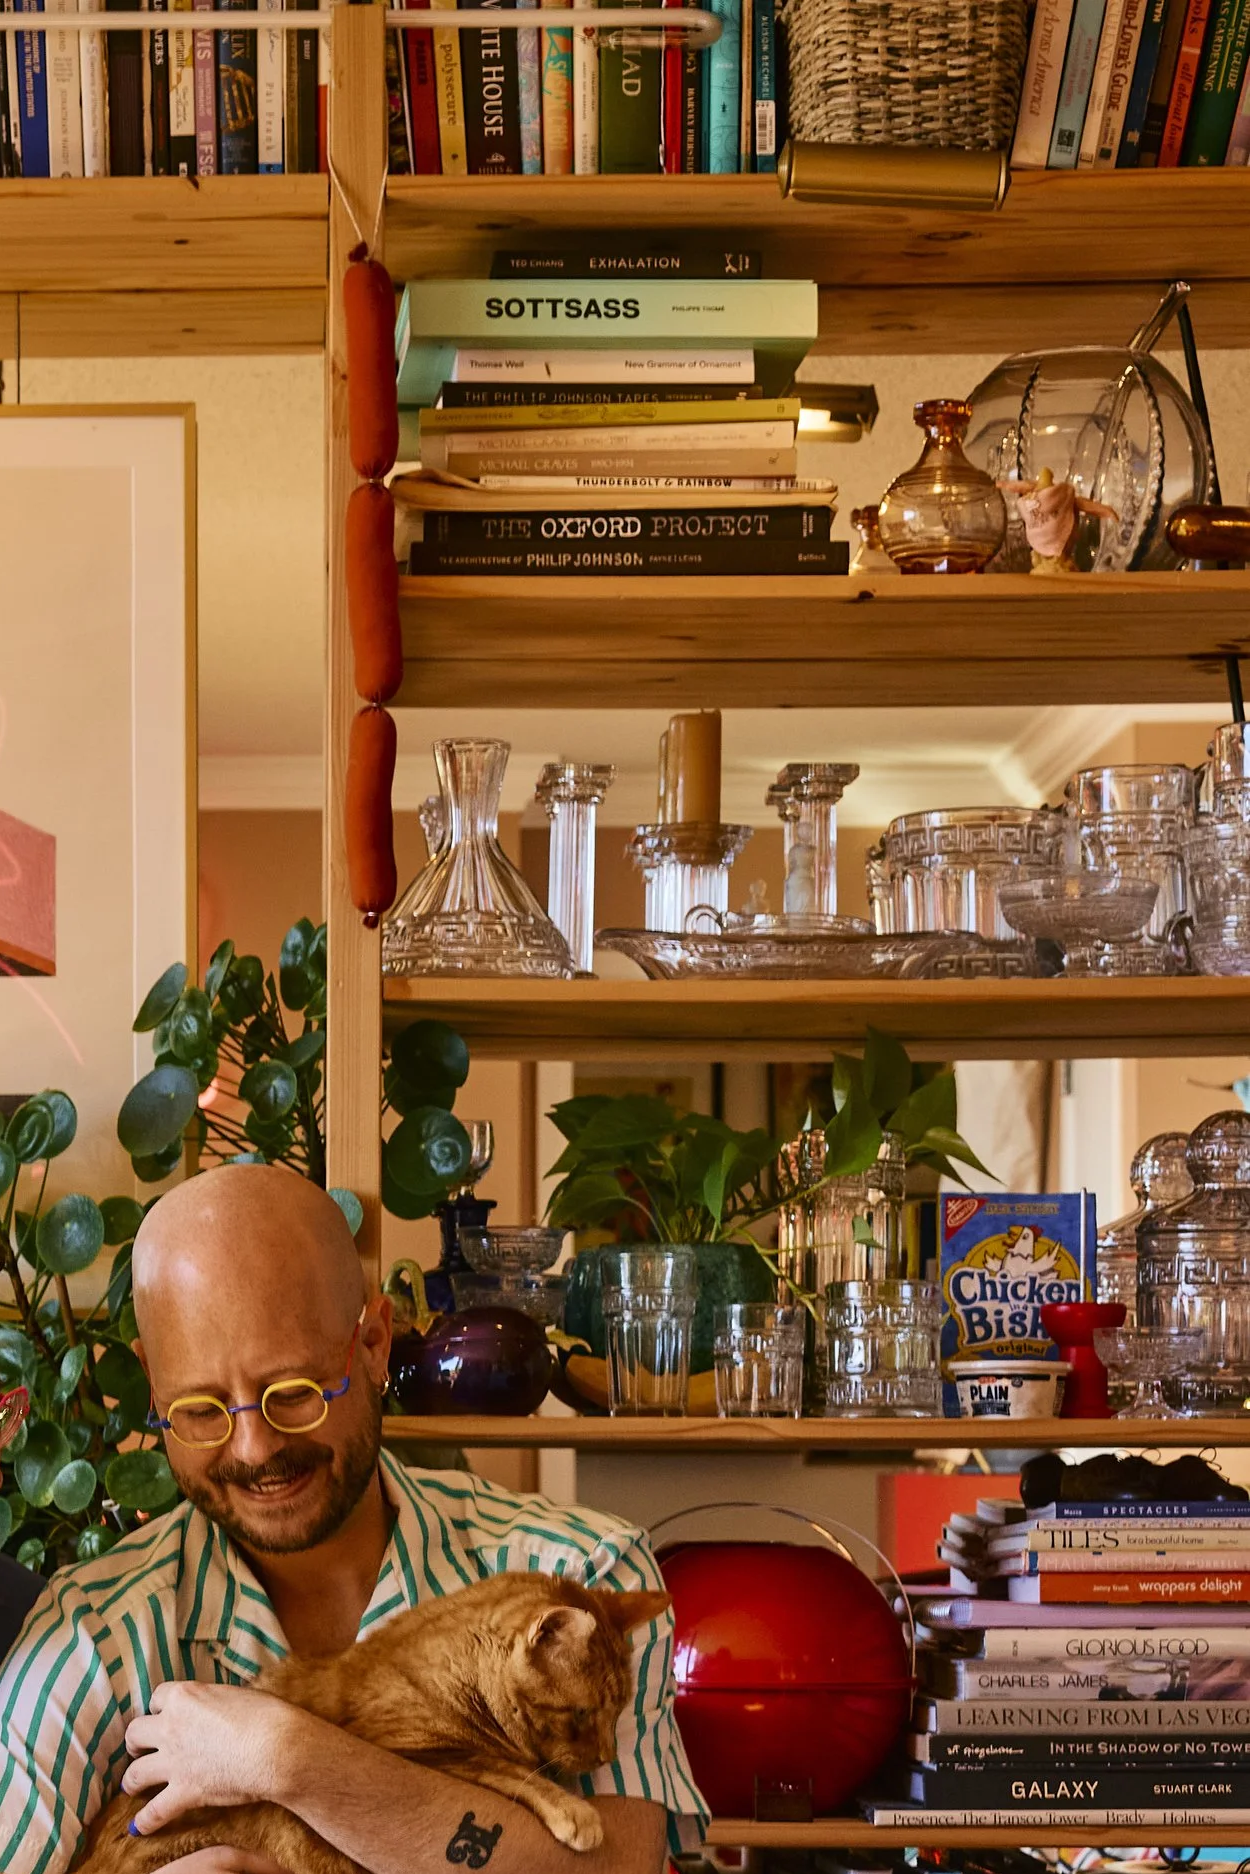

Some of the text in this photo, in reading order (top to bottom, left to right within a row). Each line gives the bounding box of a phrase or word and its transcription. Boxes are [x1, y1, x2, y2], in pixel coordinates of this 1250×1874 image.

[1202, 18, 1228, 92] GARDENING
[438, 43, 460, 126] polysecure
[1106, 72, 1128, 112] GUIDE
[481, 64, 506, 138] HOUSE
[589, 257, 680, 268] EXHALATION
[485, 297, 640, 320] SOTTSASS
[624, 360, 644, 370] New
[646, 360, 686, 372] Grammar
[699, 360, 742, 370] Ornament
[464, 391, 659, 404] THE PHILIP JOHNSON TAPES
[478, 458, 579, 472] MICHAEL GRAVES
[576, 477, 662, 488] THUNDERBOLT
[676, 477, 732, 488] RAINBOW
[482, 514, 770, 539] THE OXFORD PROJECT
[526, 552, 572, 568] PHILIP
[573, 552, 643, 568] JOHNSON
[950, 1270, 1082, 1306] Chicken
[970, 1385, 1009, 1402] PLAIN
[1103, 1506, 1188, 1516] SPECTACLES
[1044, 1530, 1204, 1550] TILES beautiful home
[1139, 1580, 1196, 1596] wrappers
[1200, 1577, 1243, 1594] delight
[1066, 1638, 1210, 1657] GLORIOUS FOOD
[978, 1674, 1108, 1688] CHARLES JAMES
[956, 1708, 1079, 1726] LEARNING
[1087, 1708, 1149, 1726] FROM
[1157, 1707, 1200, 1726] LAS
[1098, 1740, 1160, 1754] SHADOW
[1185, 1740, 1206, 1754] NO
[1012, 1780, 1233, 1800] GALAXY STUART CLARK
[960, 1810, 1216, 1826] The Transco Tower Brady Holmes
